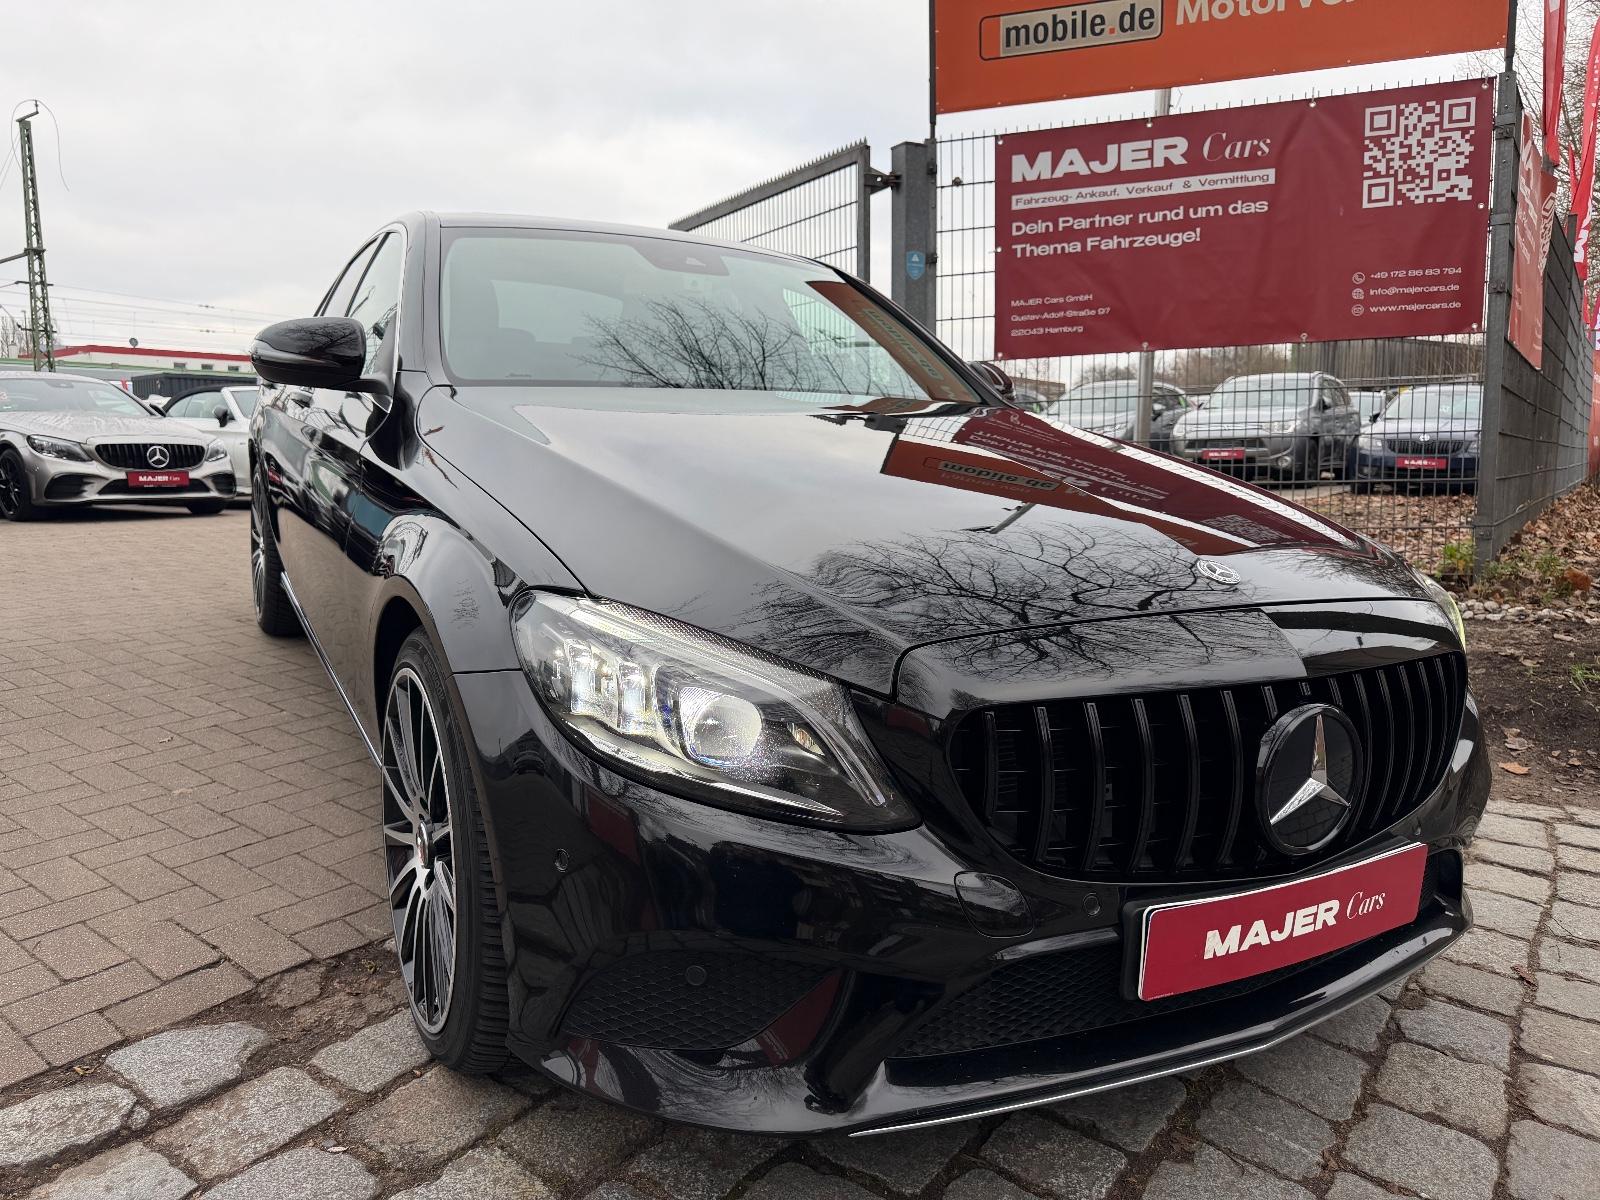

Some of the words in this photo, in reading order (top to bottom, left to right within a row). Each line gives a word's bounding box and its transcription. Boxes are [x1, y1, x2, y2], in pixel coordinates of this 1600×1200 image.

[1004, 3, 1156, 48] mobile.de
[1011, 136, 1189, 183] MAJER
[1203, 131, 1271, 162] Cars
[1015, 193, 1073, 208] Fahrzeug-
[1126, 182, 1174, 195] Verkauf
[1182, 179, 1192, 189] &
[1198, 172, 1270, 188] Vermittlung
[1011, 220, 1053, 236] Dein
[1058, 212, 1133, 231] Partner
[1138, 205, 1184, 223] rund
[1189, 203, 1223, 219] um
[1228, 199, 1269, 215] das
[1012, 240, 1082, 258] Thema
[1086, 227, 1201, 252] Fahrzeuge!
[1370, 270, 1388, 279] +49
[1390, 270, 1406, 278] 172
[1408, 269, 1424, 277] 86
[1425, 268, 1441, 276] 83
[1010, 298, 1042, 307] MAJER
[1044, 296, 1065, 305] Cars
[1065, 293, 1093, 303] GmbH
[1203, 899, 1340, 960] MAJER
[1346, 890, 1386, 920] Cars
